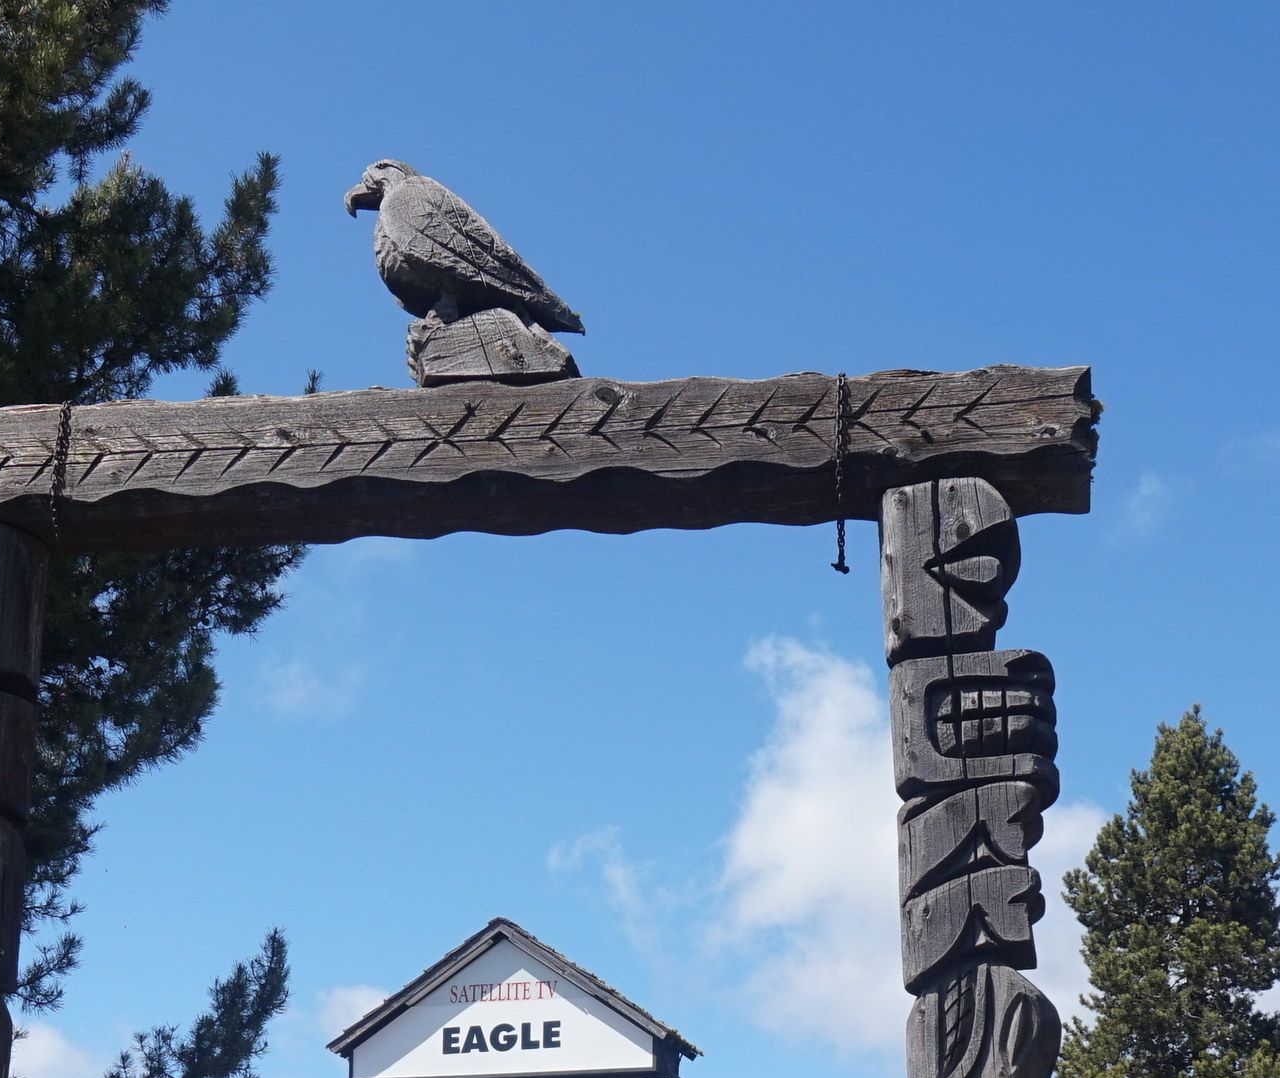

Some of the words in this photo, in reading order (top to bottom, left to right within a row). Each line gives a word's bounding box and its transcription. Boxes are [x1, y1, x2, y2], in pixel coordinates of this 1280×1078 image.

[450, 981, 531, 1004] SATELLITE
[535, 980, 558, 1000] TV
[442, 1020, 561, 1055] EAGLE
